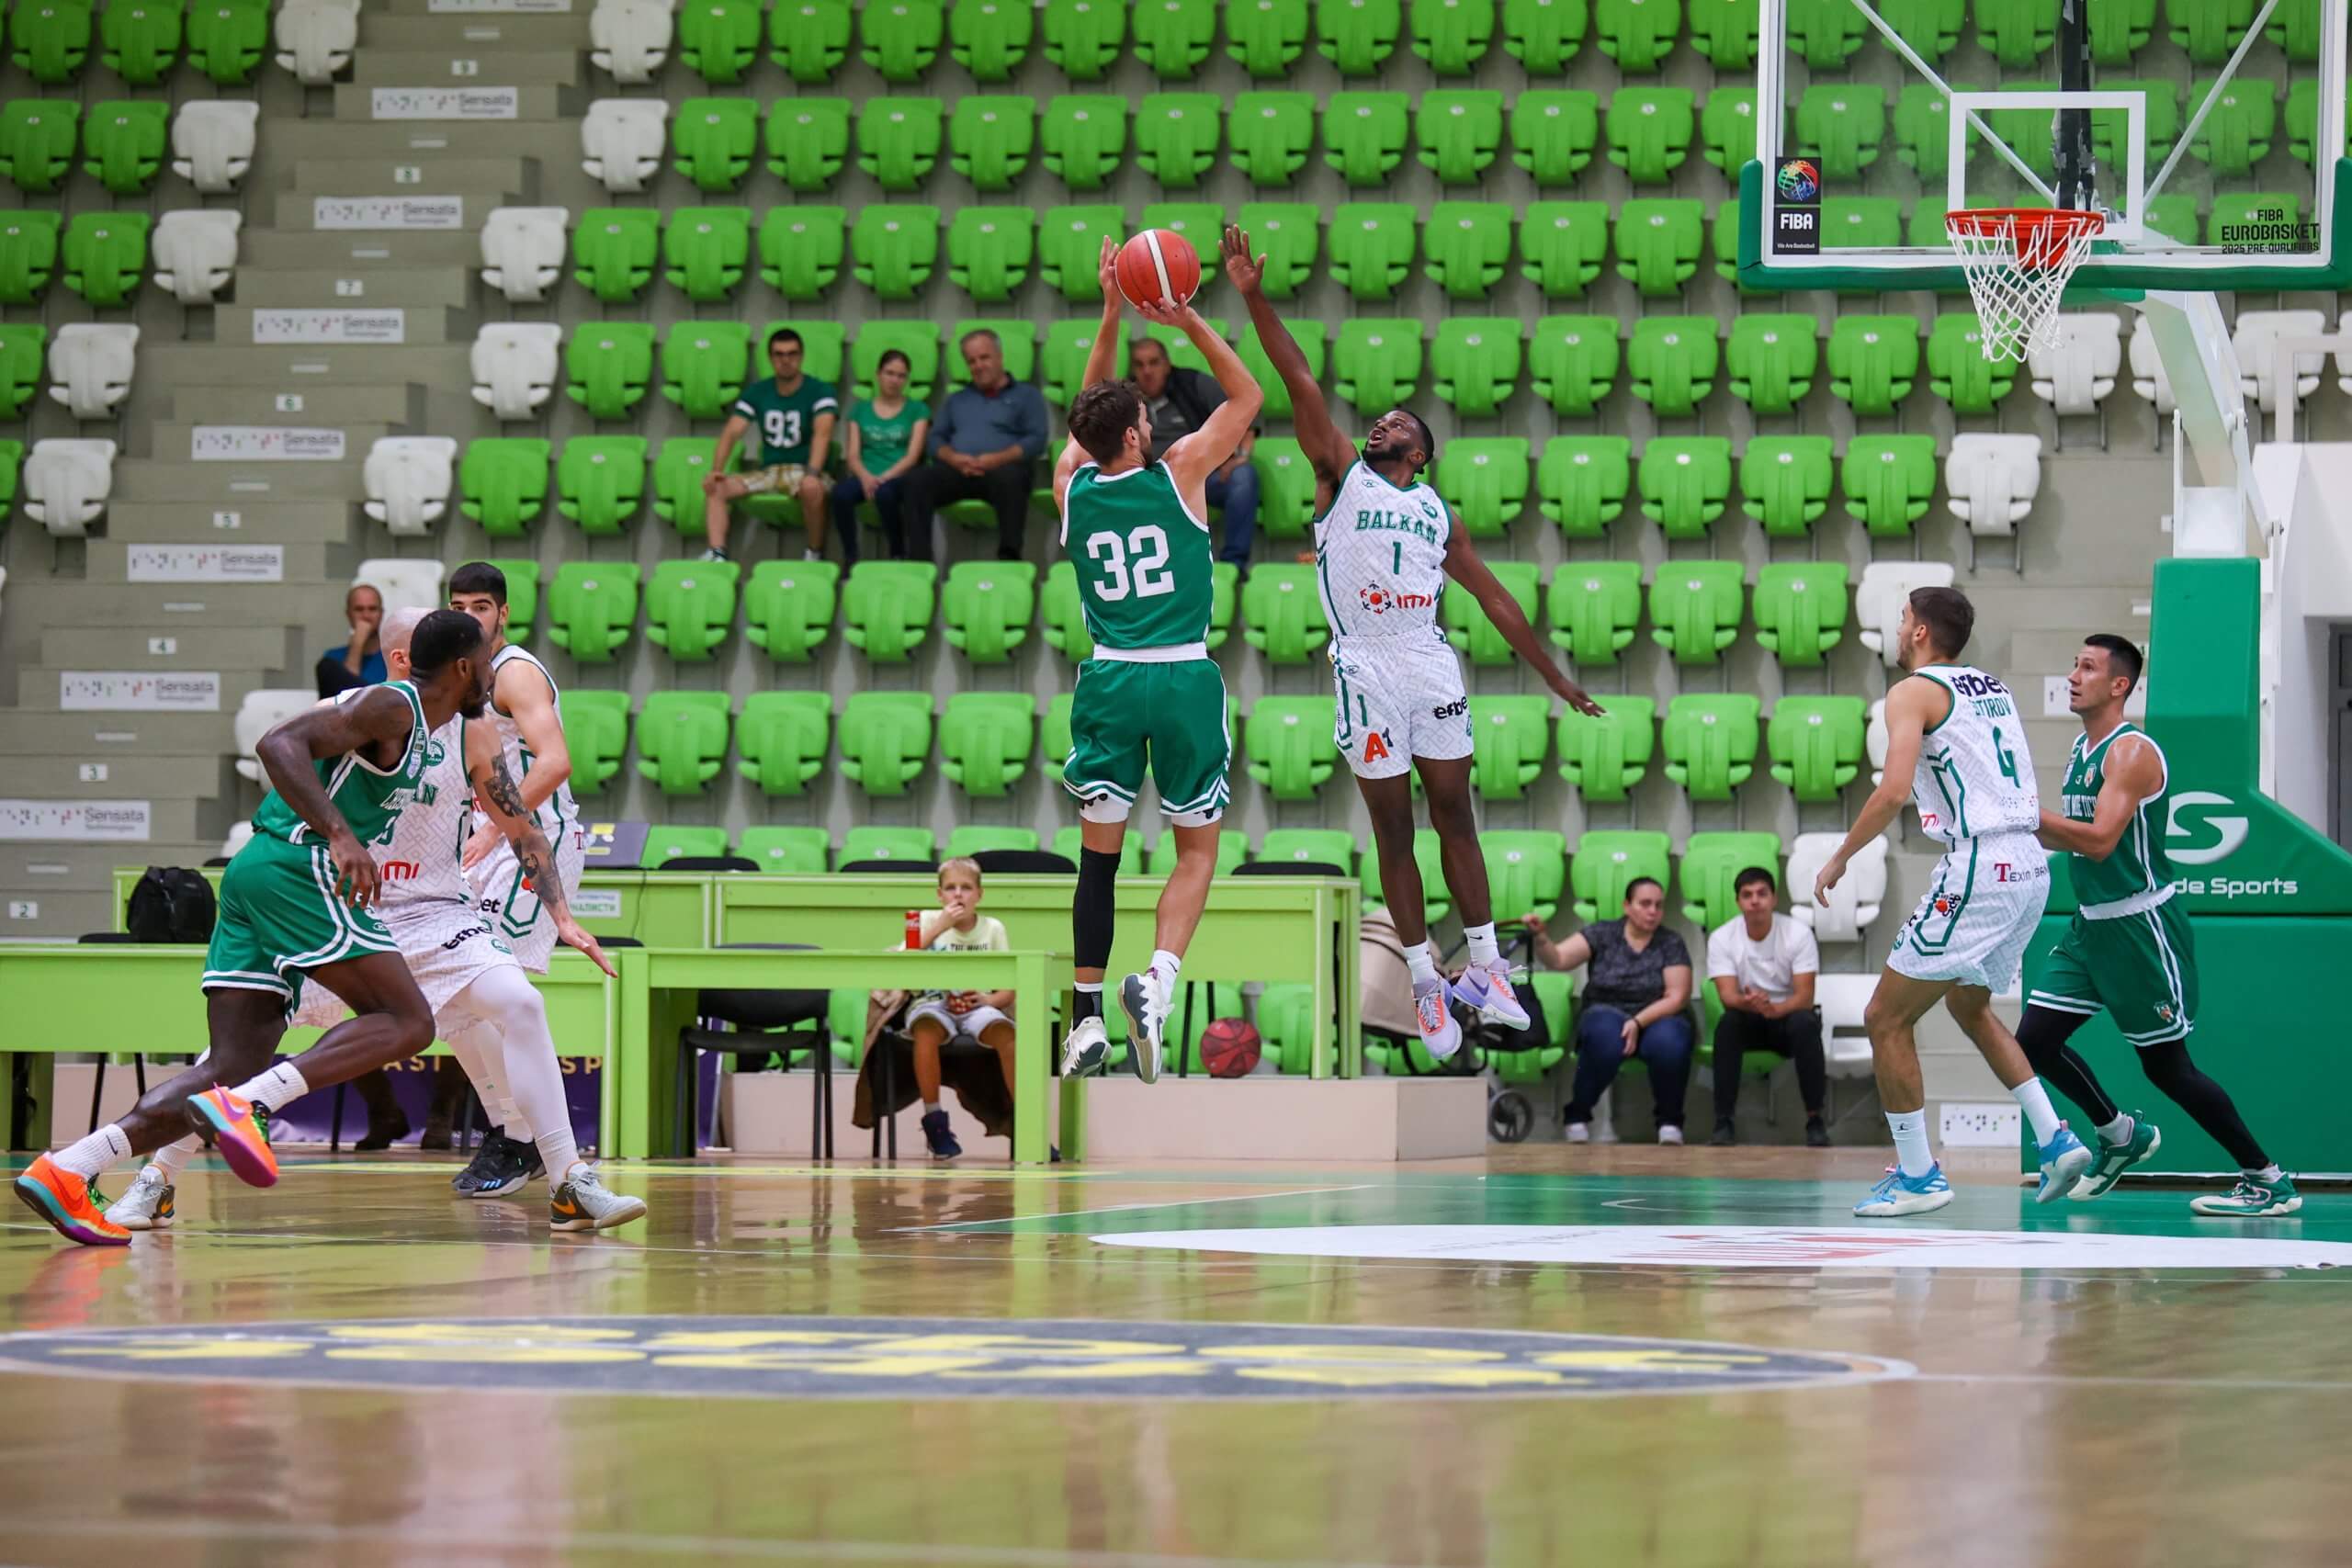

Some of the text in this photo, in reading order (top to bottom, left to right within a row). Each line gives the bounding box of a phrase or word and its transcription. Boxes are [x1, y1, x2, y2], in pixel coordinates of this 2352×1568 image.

[1780, 213, 1813, 230] FIBA
[2257, 209, 2283, 221] FIBA
[2222, 223, 2320, 241] EUROBASKET
[2222, 243, 2245, 254] 2025
[764, 410, 801, 448] 93
[1356, 509, 1437, 545] BALKAN
[220, 551, 278, 567] Sensata
[1086, 524, 1175, 602] 32
[1393, 541, 1402, 575] 1
[157, 639, 166, 653] 4
[155, 678, 215, 693] Sensata
[1357, 694, 1368, 727] 1
[88, 766, 97, 780] 3
[85, 807, 145, 823] Sensata
[2211, 877, 2298, 899] Sports
[19, 904, 29, 918] 2
